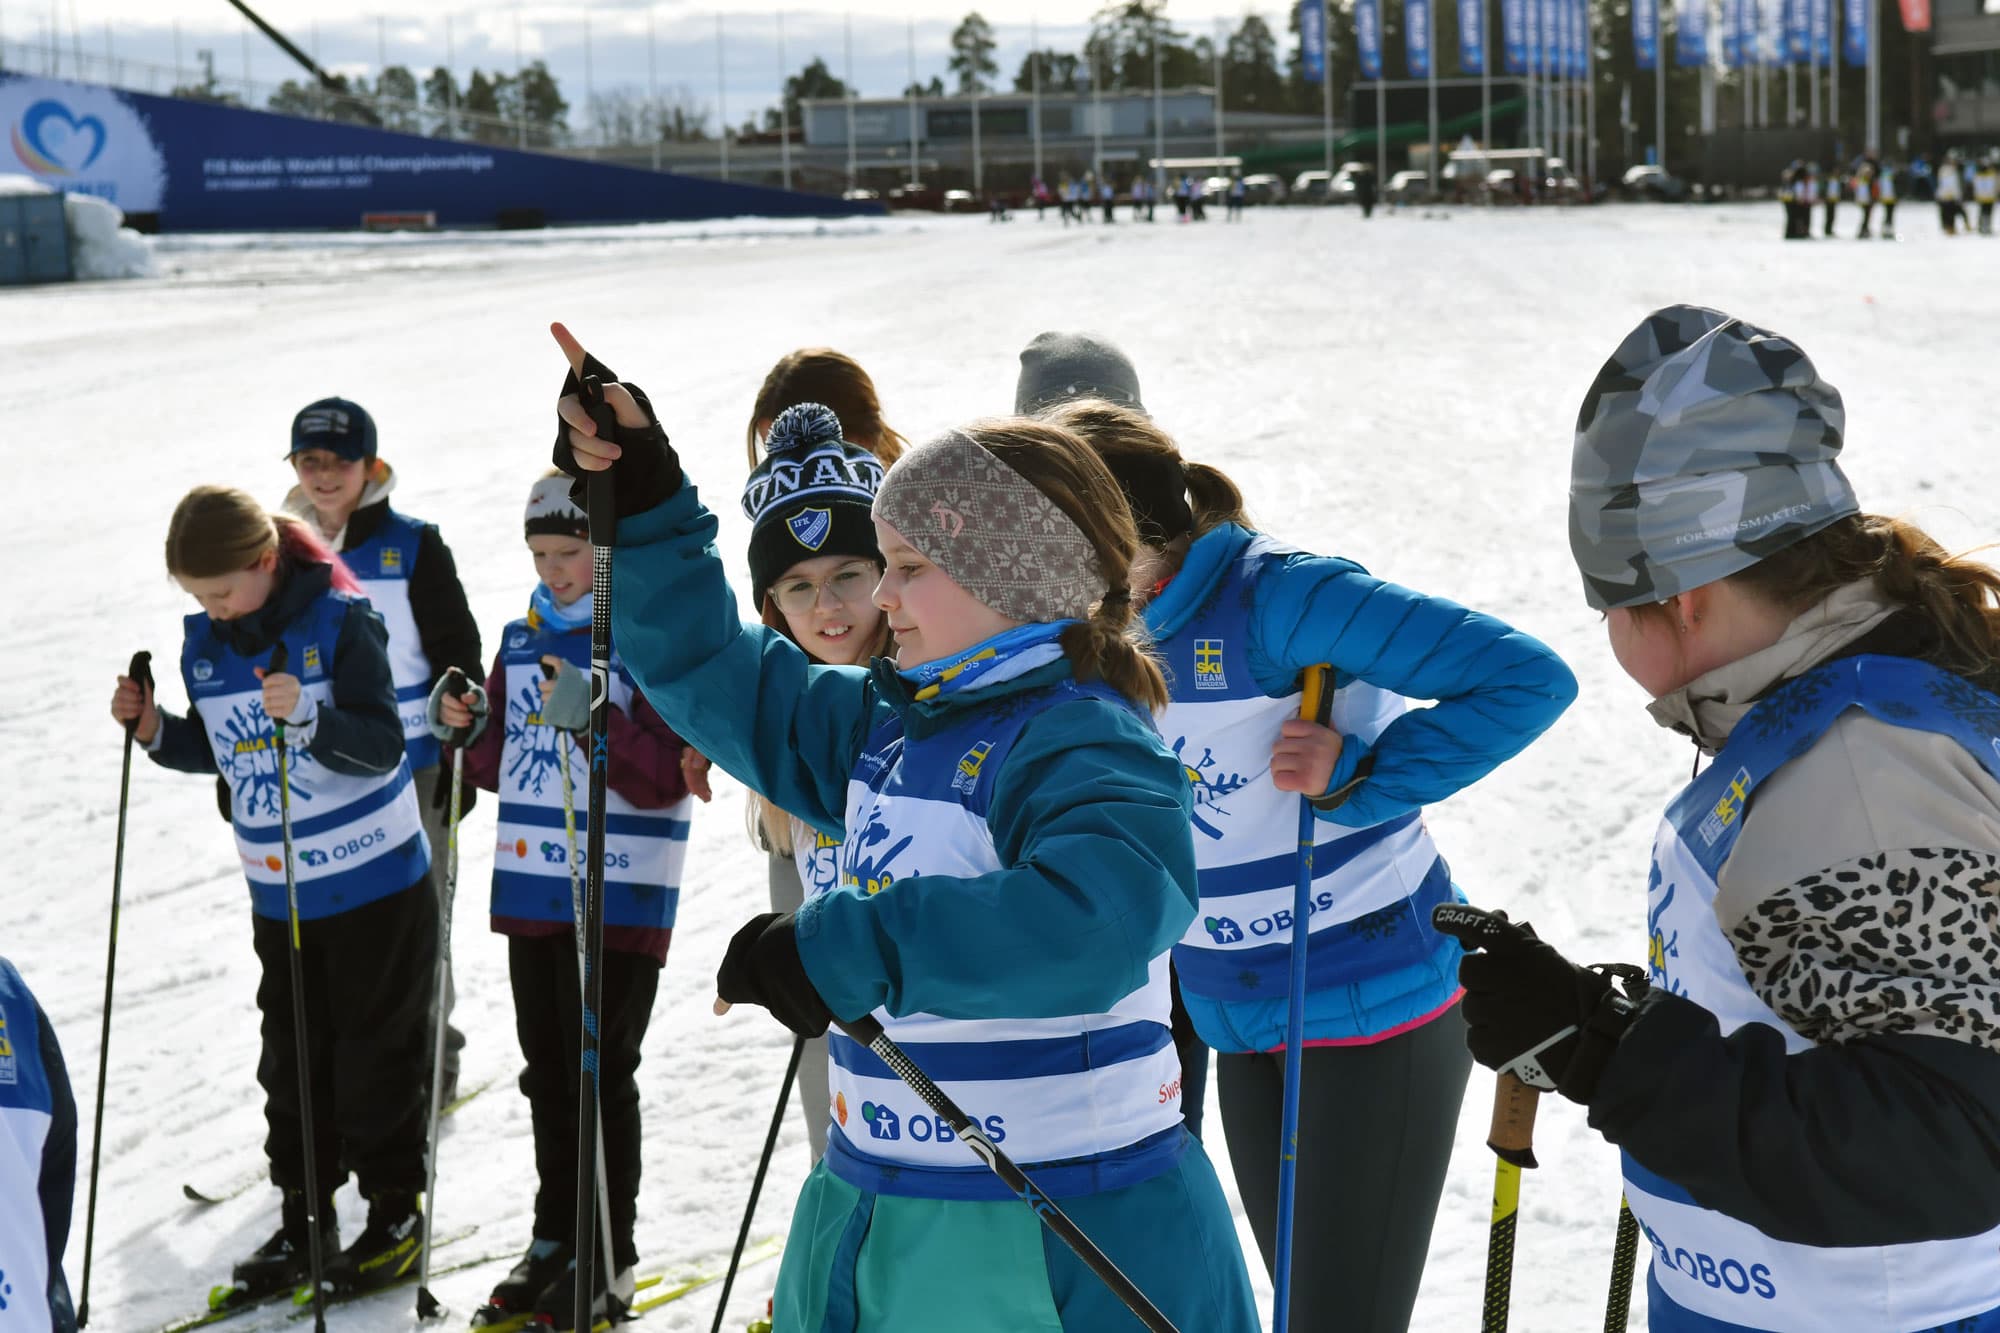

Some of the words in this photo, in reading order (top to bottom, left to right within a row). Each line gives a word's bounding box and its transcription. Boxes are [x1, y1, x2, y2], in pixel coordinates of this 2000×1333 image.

[1196, 662, 1222, 673] SKI
[1197, 674, 1223, 682] TEAM
[332, 828, 385, 860] OBOS
[575, 849, 629, 868] OOS
[1436, 910, 1485, 927] CRAFT
[1675, 1247, 1776, 1300] OBOS
